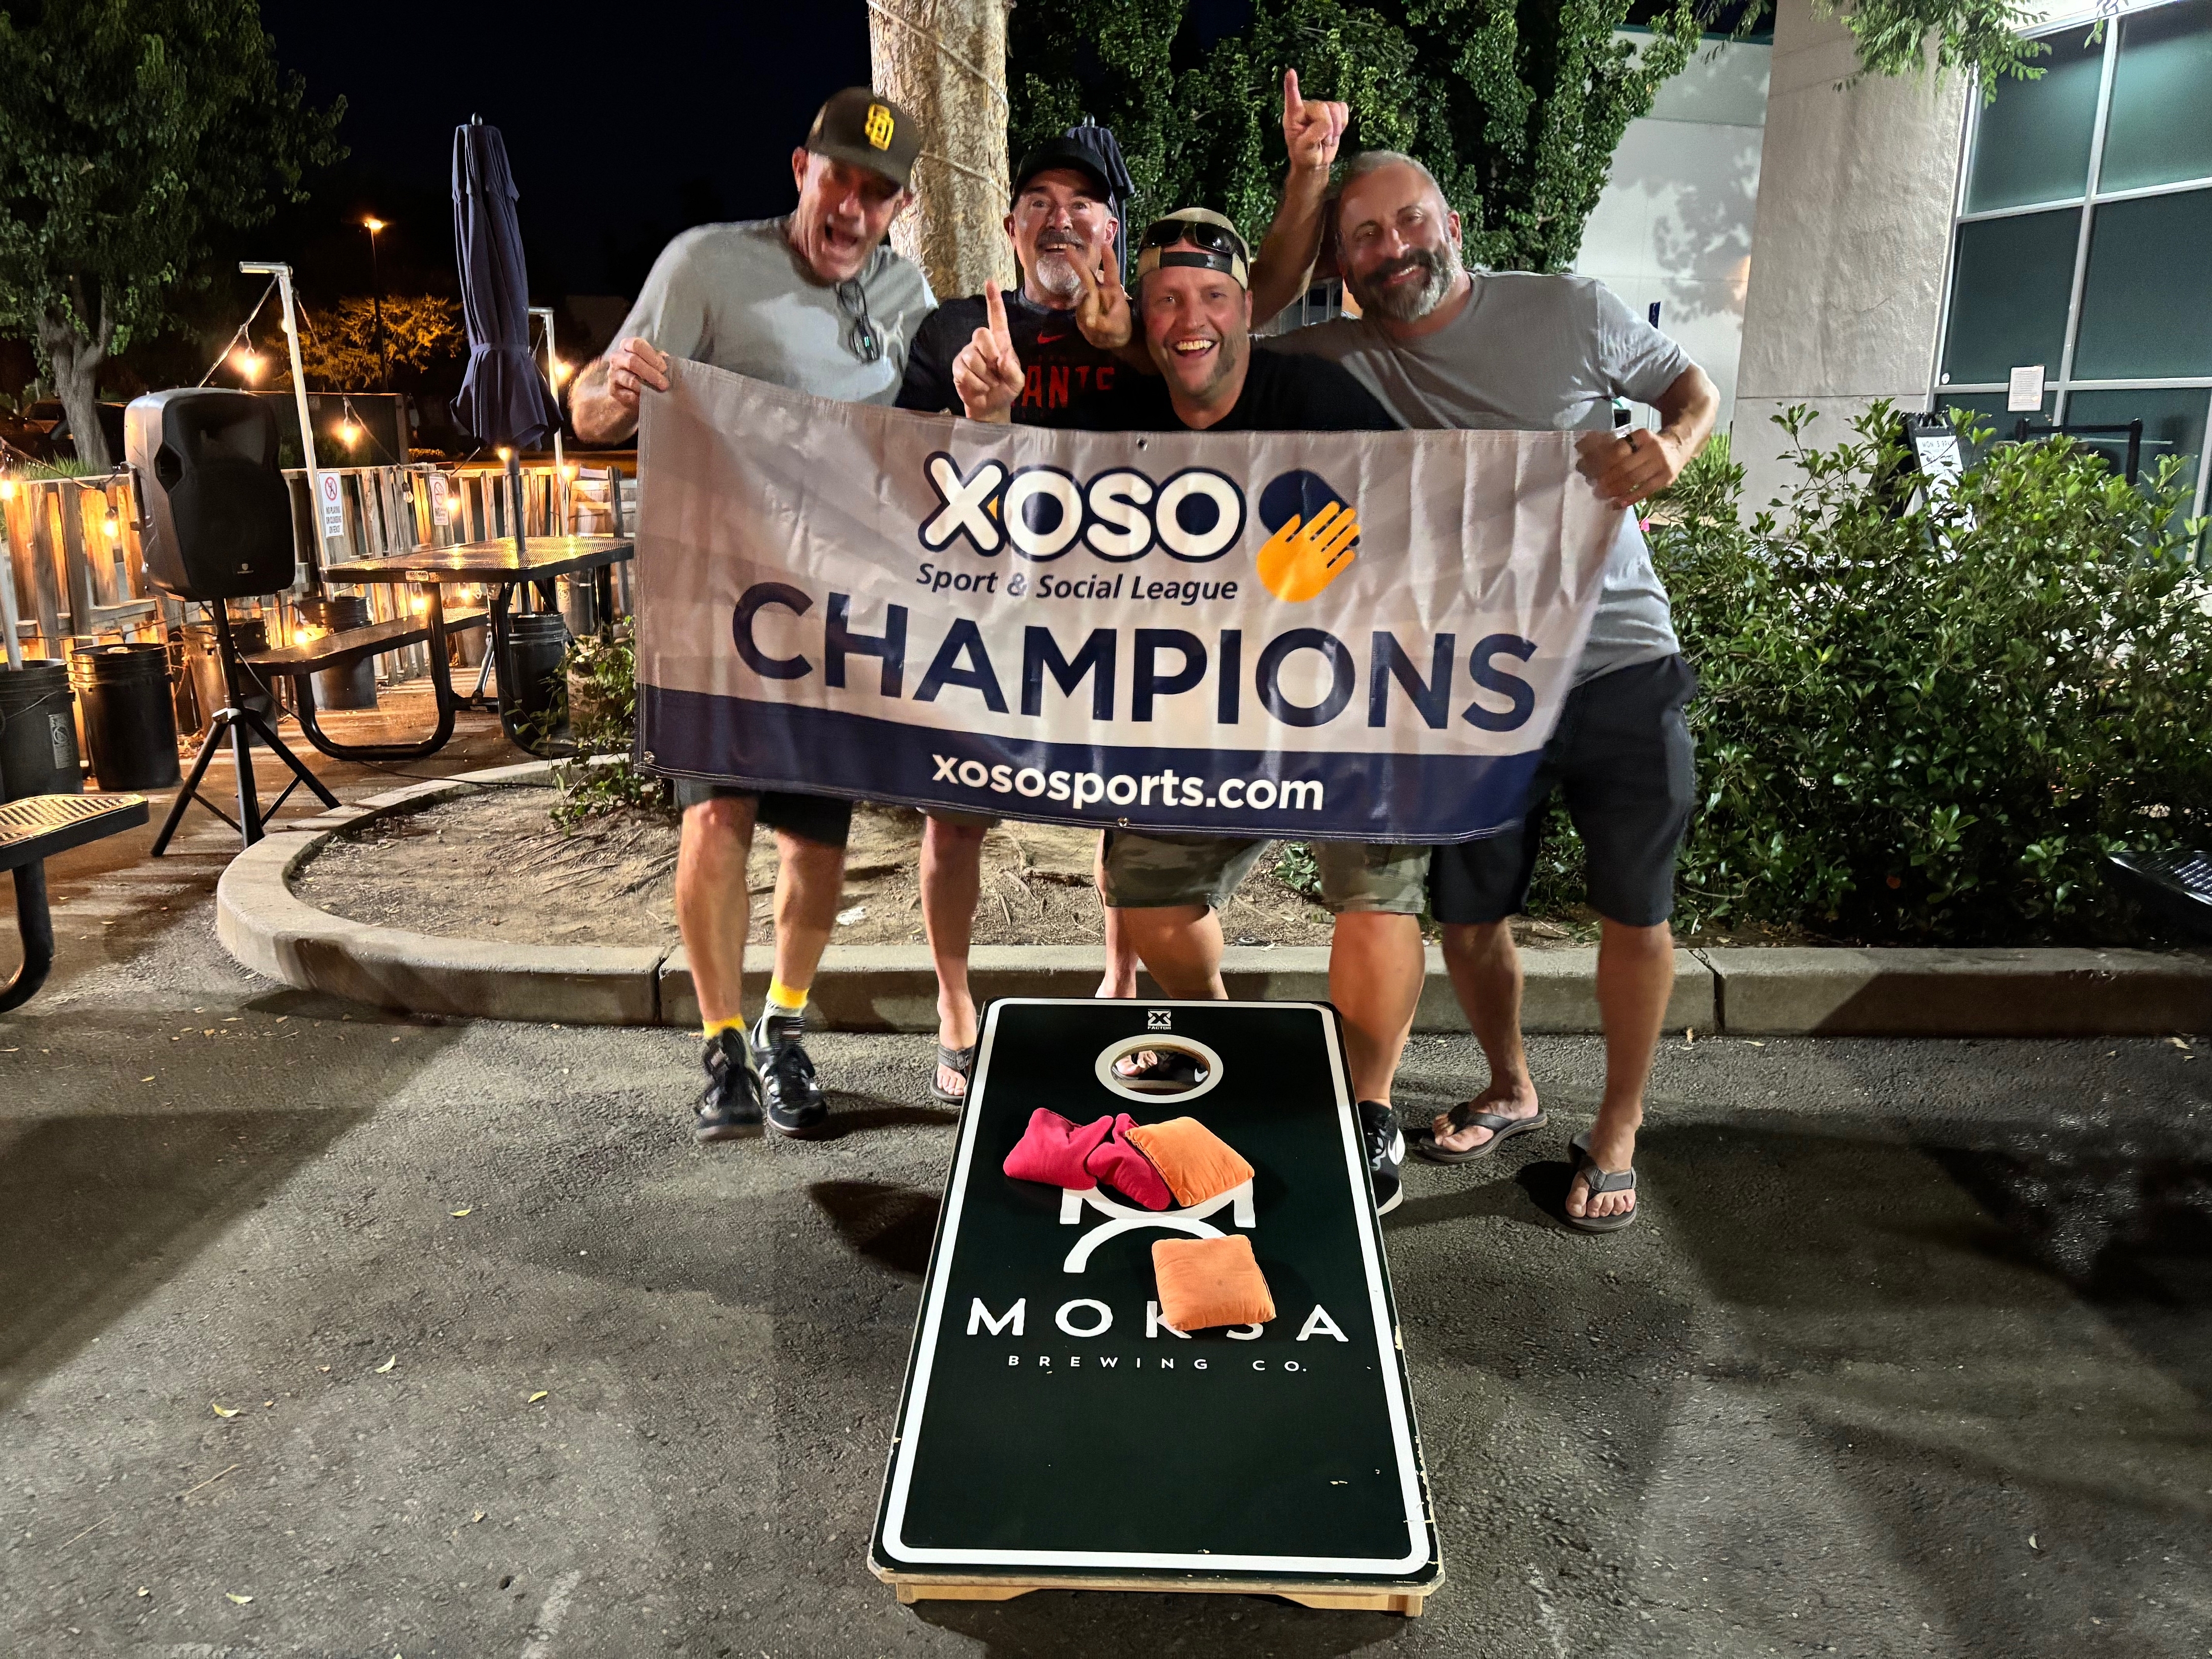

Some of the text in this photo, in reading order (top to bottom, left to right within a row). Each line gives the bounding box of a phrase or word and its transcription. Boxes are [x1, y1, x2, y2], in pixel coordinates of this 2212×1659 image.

[919, 451, 1247, 563] XOSO
[916, 562, 1238, 606] Sport & Social League
[733, 583, 1537, 733] CHAMPIONS
[932, 752, 1323, 812] xososports.com
[1008, 1355, 1307, 1372] BREWING CO.
